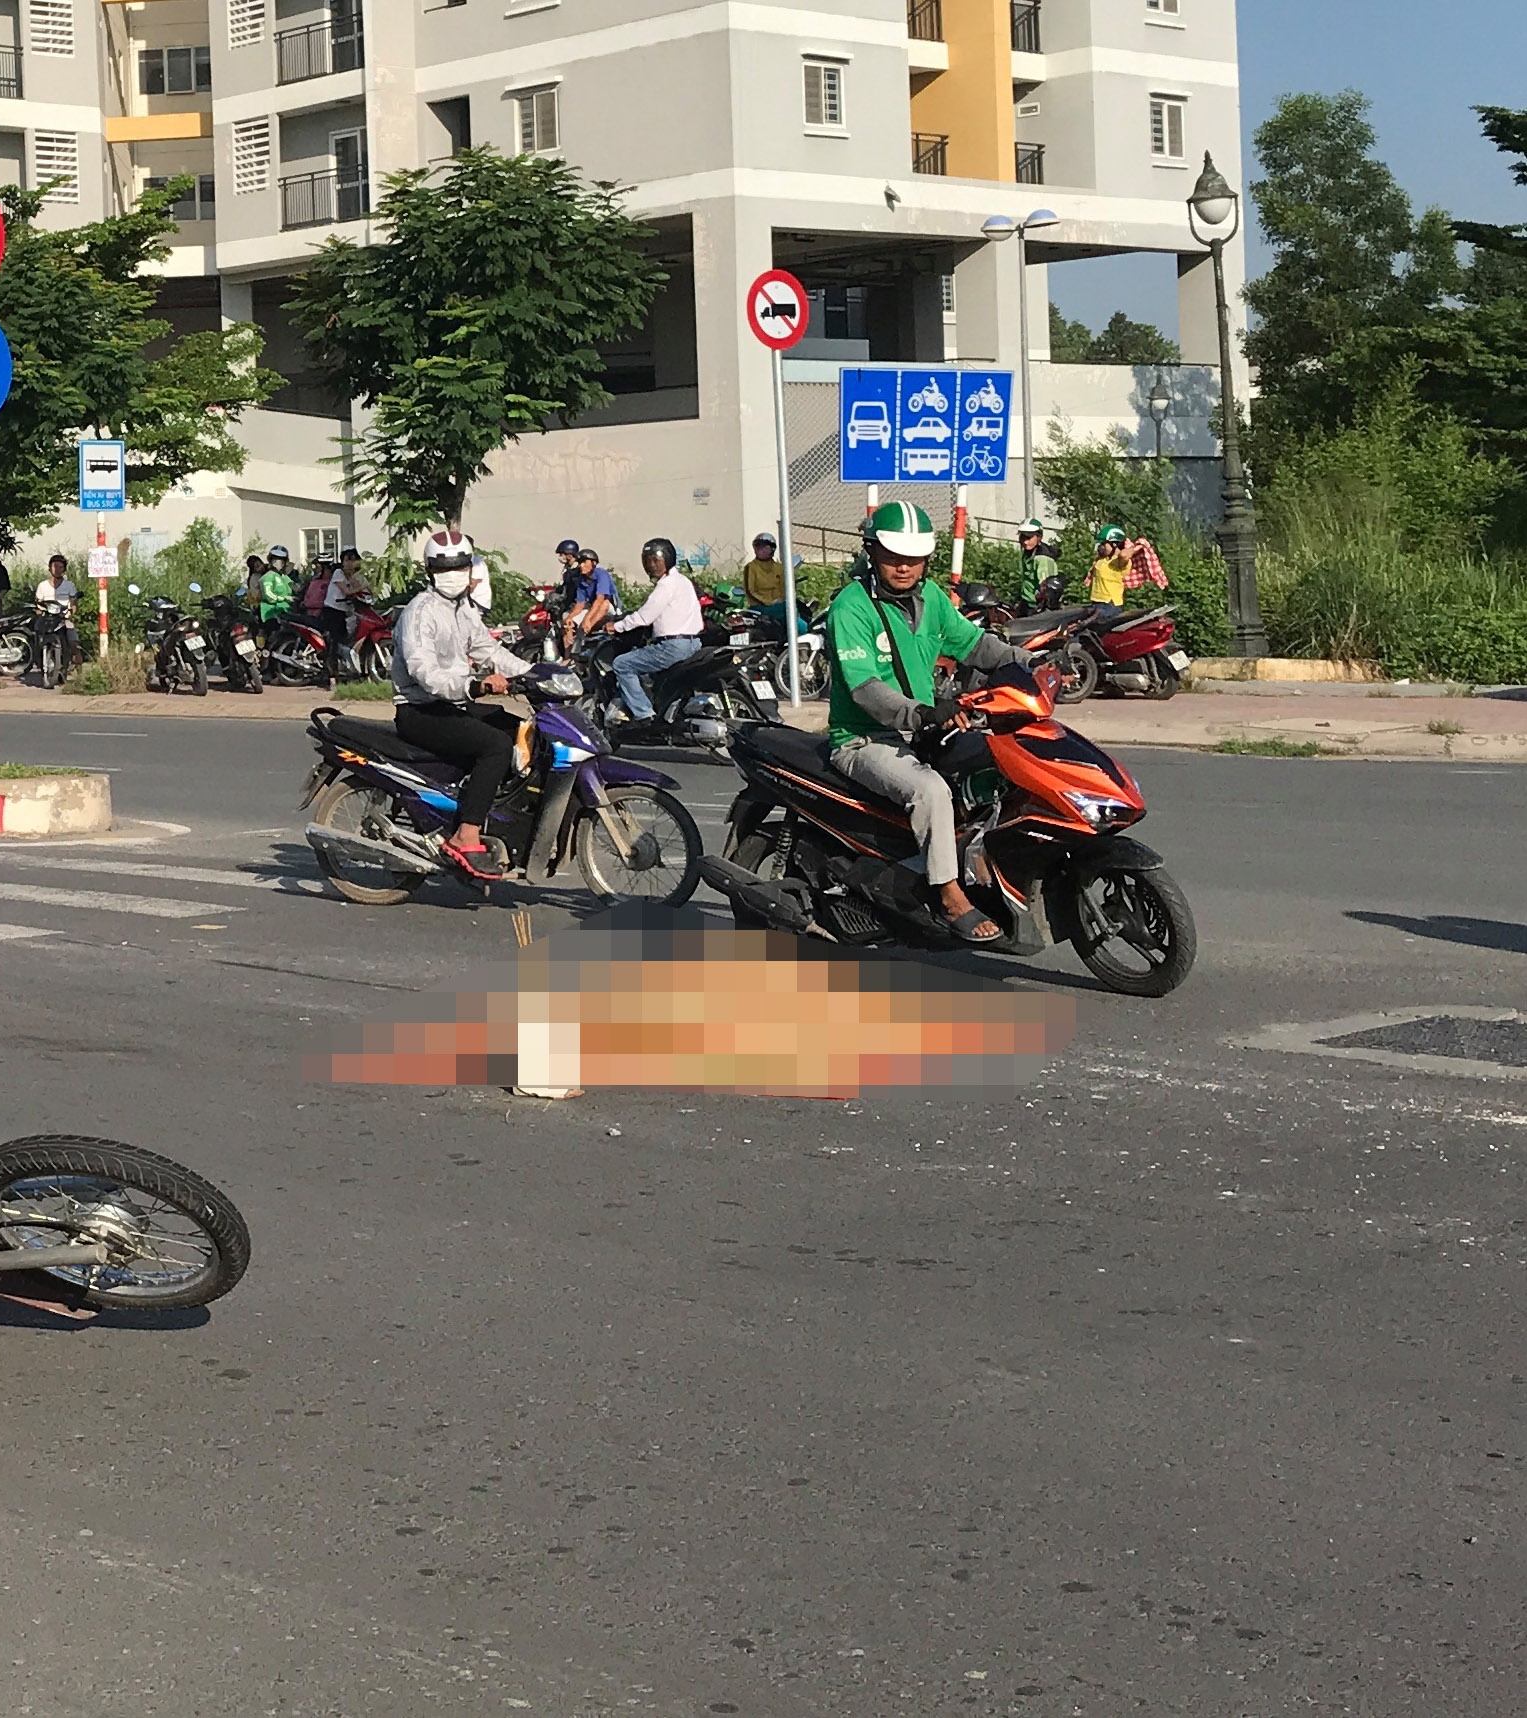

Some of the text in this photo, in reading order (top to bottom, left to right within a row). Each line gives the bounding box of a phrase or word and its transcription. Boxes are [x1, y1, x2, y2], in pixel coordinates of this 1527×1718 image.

[87, 499, 118, 508] BUS STOP
[877, 654, 893, 663] Gra
